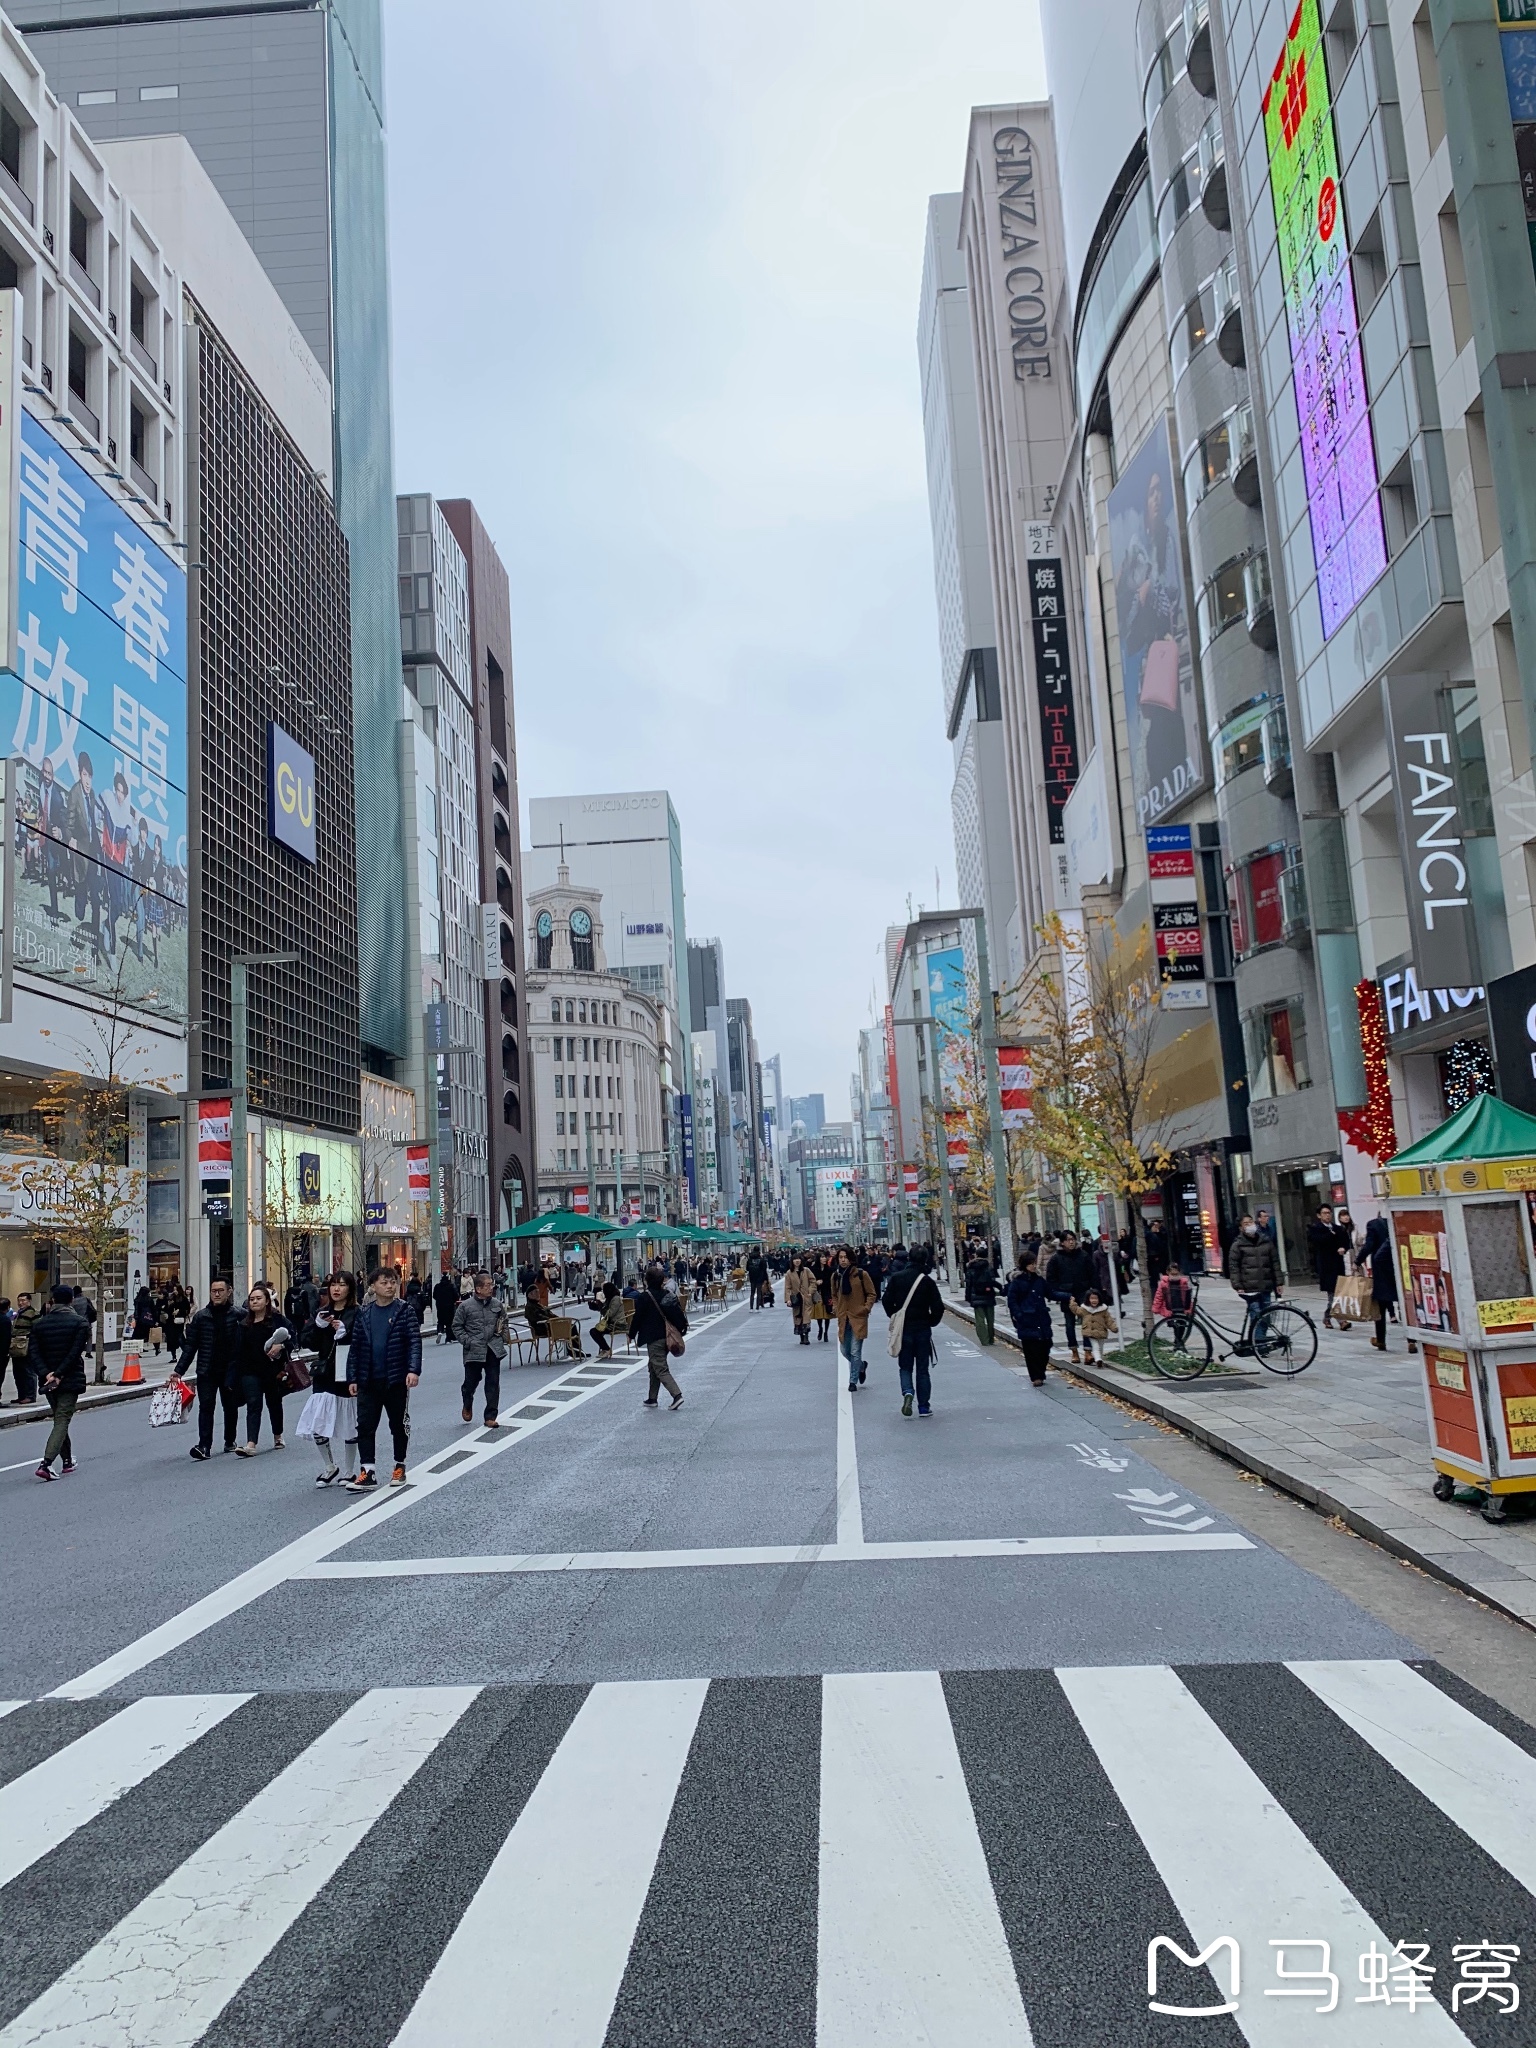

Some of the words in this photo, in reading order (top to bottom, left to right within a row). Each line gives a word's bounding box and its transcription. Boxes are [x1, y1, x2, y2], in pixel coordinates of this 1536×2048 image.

[993, 126, 1040, 262] GINZA
[1006, 266, 1052, 382] CORE
[1028, 525, 1056, 539] 地下
[1032, 540, 1055, 554] 2F
[20, 438, 170, 684] 青春
[1035, 568, 1067, 694] 焼肉トラジ
[276, 760, 313, 829] GU
[582, 797, 662, 813] MIKIMOTO
[1138, 756, 1199, 826] PRADA
[1403, 732, 1469, 931] FANCL
[486, 912, 498, 972] TASAKI
[1163, 931, 1199, 945] ECC
[1164, 964, 1199, 973] PRADA
[886, 1007, 895, 1056] MITSUKOSHI
[455, 1130, 489, 1160] TASAKI
[304, 1168, 320, 1190] GU
[825, 1171, 851, 1180] LIXIL
[365, 1208, 386, 1220] GU
